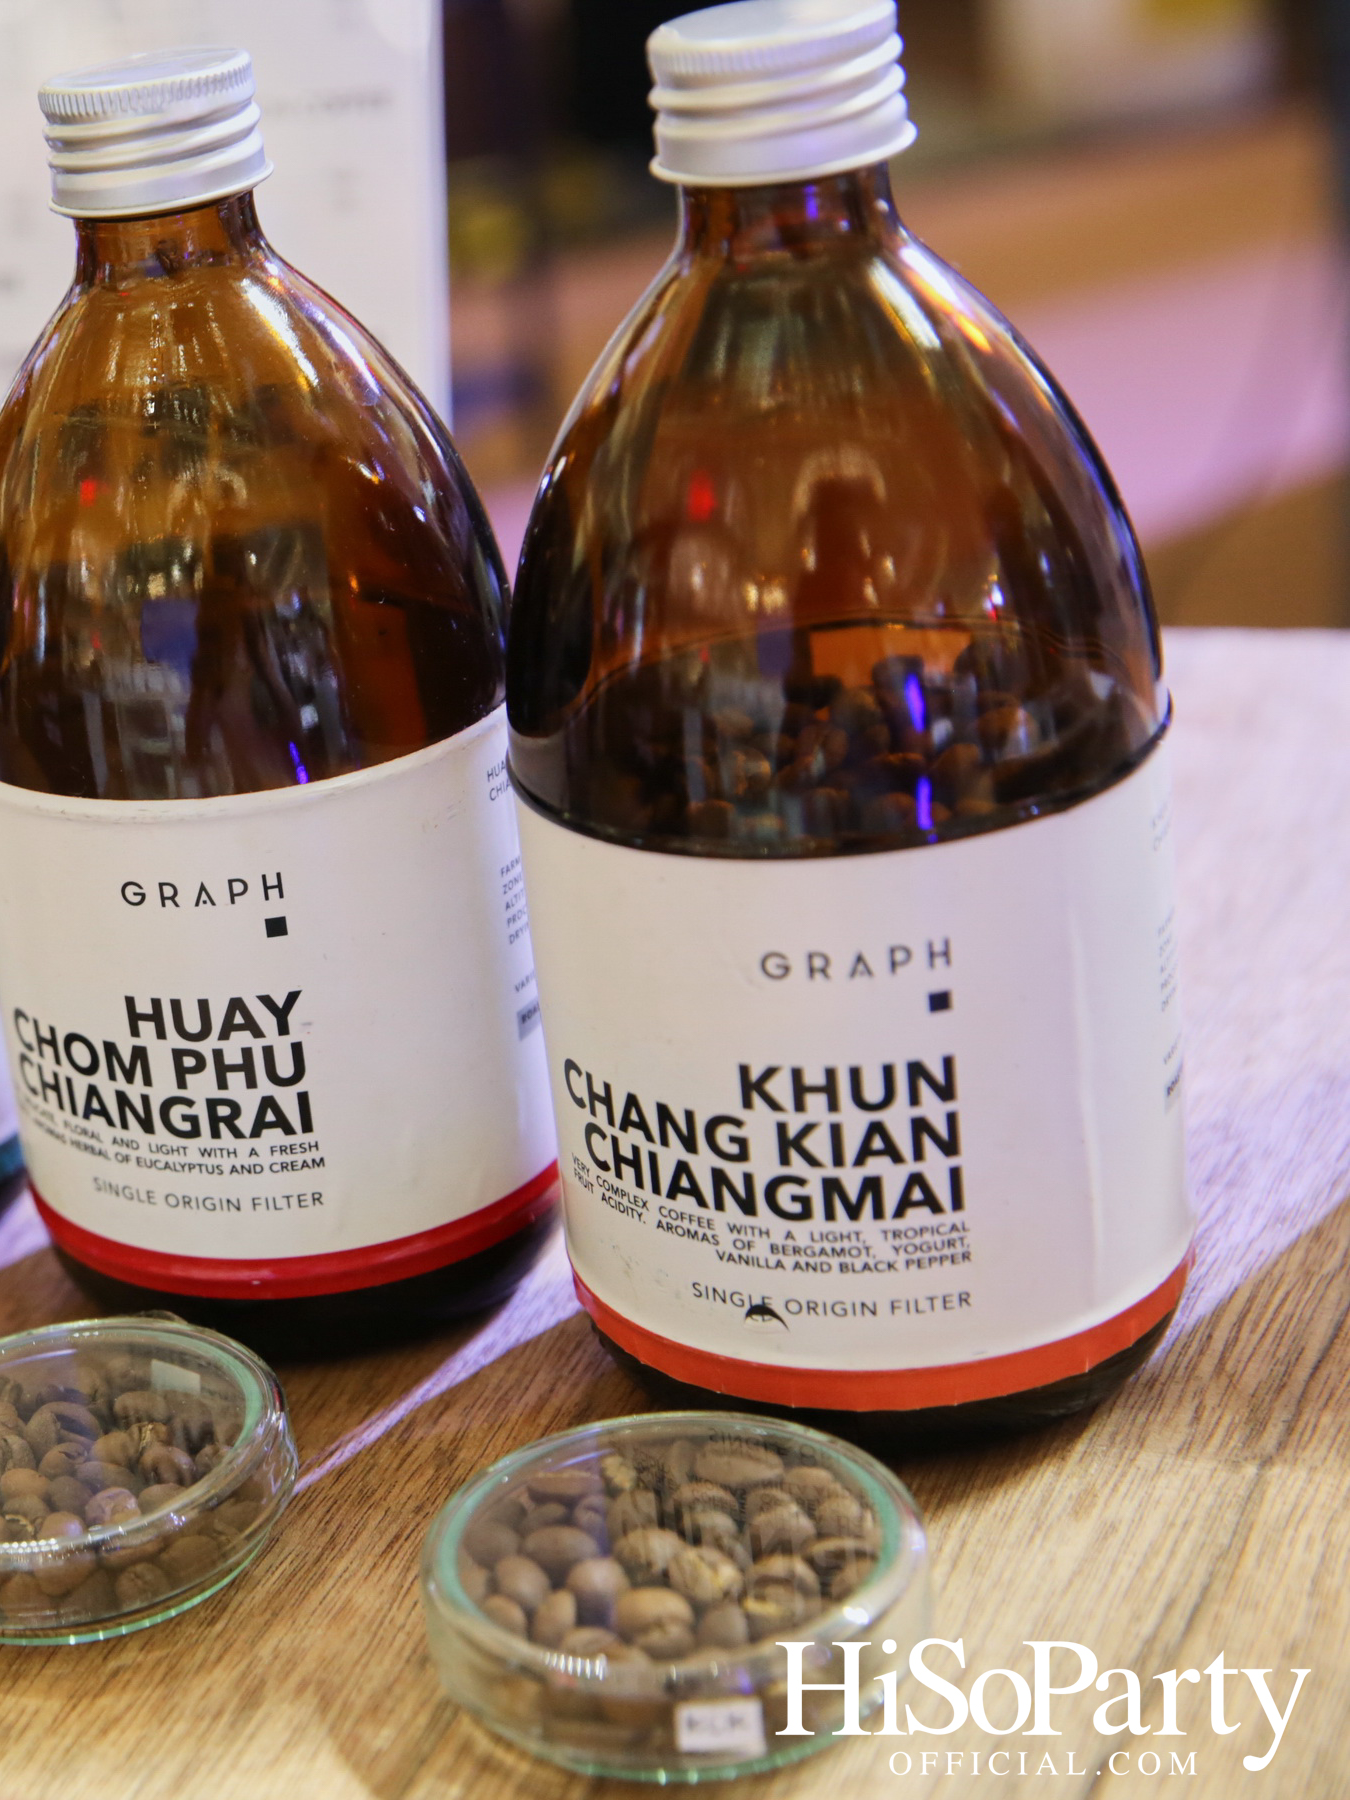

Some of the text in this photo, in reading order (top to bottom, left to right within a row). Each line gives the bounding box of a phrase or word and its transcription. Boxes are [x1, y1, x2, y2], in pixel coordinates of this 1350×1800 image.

[486, 759, 507, 783] HUA
[489, 777, 512, 801] CHIA
[120, 872, 285, 908] GRAPH
[760, 937, 953, 982] GRAPH
[124, 989, 303, 1042] HUAY
[13, 1006, 307, 1091] CHOM PHU
[17, 1051, 314, 1140] CHIANGRAI
[737, 1055, 958, 1115] KHUN
[564, 1057, 961, 1168] CHANG KIAN
[112, 1136, 140, 1151] AND
[148, 1142, 189, 1157] LIGHT
[200, 1147, 238, 1159] WITH
[248, 1147, 260, 1158] A
[270, 1140, 319, 1157] FRESH
[114, 1151, 132, 1165] OF
[136, 1156, 224, 1176] EUCALYPTUS
[229, 1163, 264, 1175] AND
[269, 1157, 326, 1174] CREAM
[93, 1176, 324, 1212] SINGLE ORIGIN FILTER
[584, 1122, 967, 1222] CHIANGMAI
[572, 1152, 970, 1245] VERY COMPLEX COFFEE WITH A LIGHT, TROPICAL
[574, 1168, 971, 1259] FRUIT ACIDITY. AROMAS OF BERGAMOT, YOGURT,
[716, 1249, 973, 1274] VANILLA AND BLACK PEPPER
[692, 1281, 973, 1322] SINGLE ORIGIN FILTER
